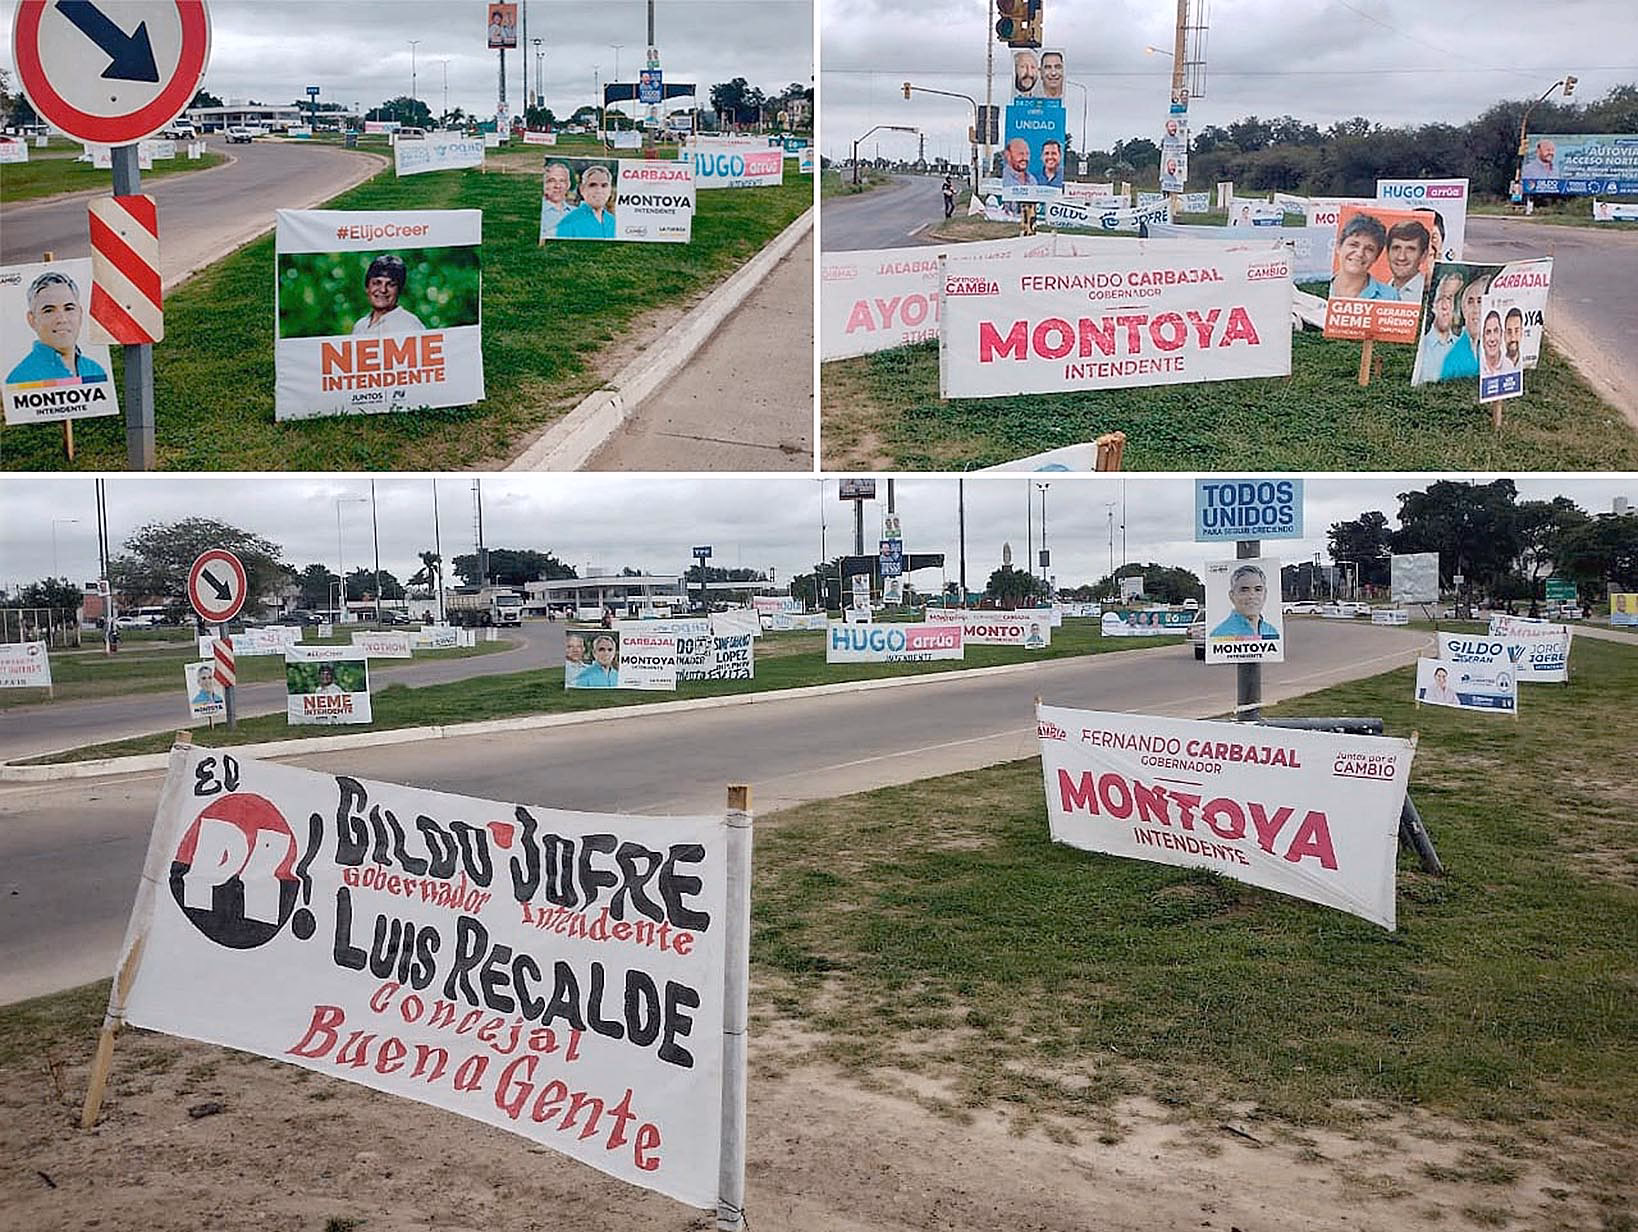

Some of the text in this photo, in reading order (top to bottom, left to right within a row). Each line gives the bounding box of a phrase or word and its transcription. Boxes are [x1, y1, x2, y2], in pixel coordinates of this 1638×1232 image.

[1015, 120, 1056, 130] UNIDAD
[622, 169, 691, 181] CARBAJAL
[1382, 186, 1425, 198] HUGO
[617, 194, 691, 208] MONTOYA
[336, 223, 429, 241] #ElijoCreer
[1021, 268, 1225, 291] FERNANDO CARBAJAL
[1247, 266, 1288, 279] CAMBIO
[945, 281, 999, 293] CAMBIA
[1088, 288, 1162, 300] GOBERNADOR
[1332, 302, 1374, 315] GABY
[1329, 314, 1372, 328] NEME
[979, 306, 1261, 363] MONTOYA
[322, 334, 445, 375] NEME
[1064, 356, 1186, 380] INTENDENTE
[322, 367, 446, 391] INTENDENTE
[13, 387, 107, 410] MONTOYA
[351, 392, 383, 402] JUNTOS
[36, 404, 88, 416] INTENDENTE
[1202, 481, 1294, 507] TODOS
[1202, 505, 1294, 527] UNIDOS
[832, 627, 905, 652] HUGO
[963, 625, 1025, 637] MONTO
[623, 638, 675, 646] CARBAJAL
[1213, 643, 1278, 654] MONTOYA
[1448, 640, 1503, 656] GILDO
[620, 656, 676, 666] MONTOYA
[304, 694, 353, 710] NEME
[1081, 729, 1301, 768] FERNANDO CARBAJAL
[1141, 755, 1222, 775] GOBERNADOR
[1334, 760, 1395, 777] CAMBIO
[1057, 768, 1339, 871] MONTOYA
[1133, 826, 1250, 866] INTENDENTE
[510, 806, 711, 933] JOFRE
[334, 886, 700, 1069] LUIS RECALDE
[370, 981, 582, 1062] Concejal
